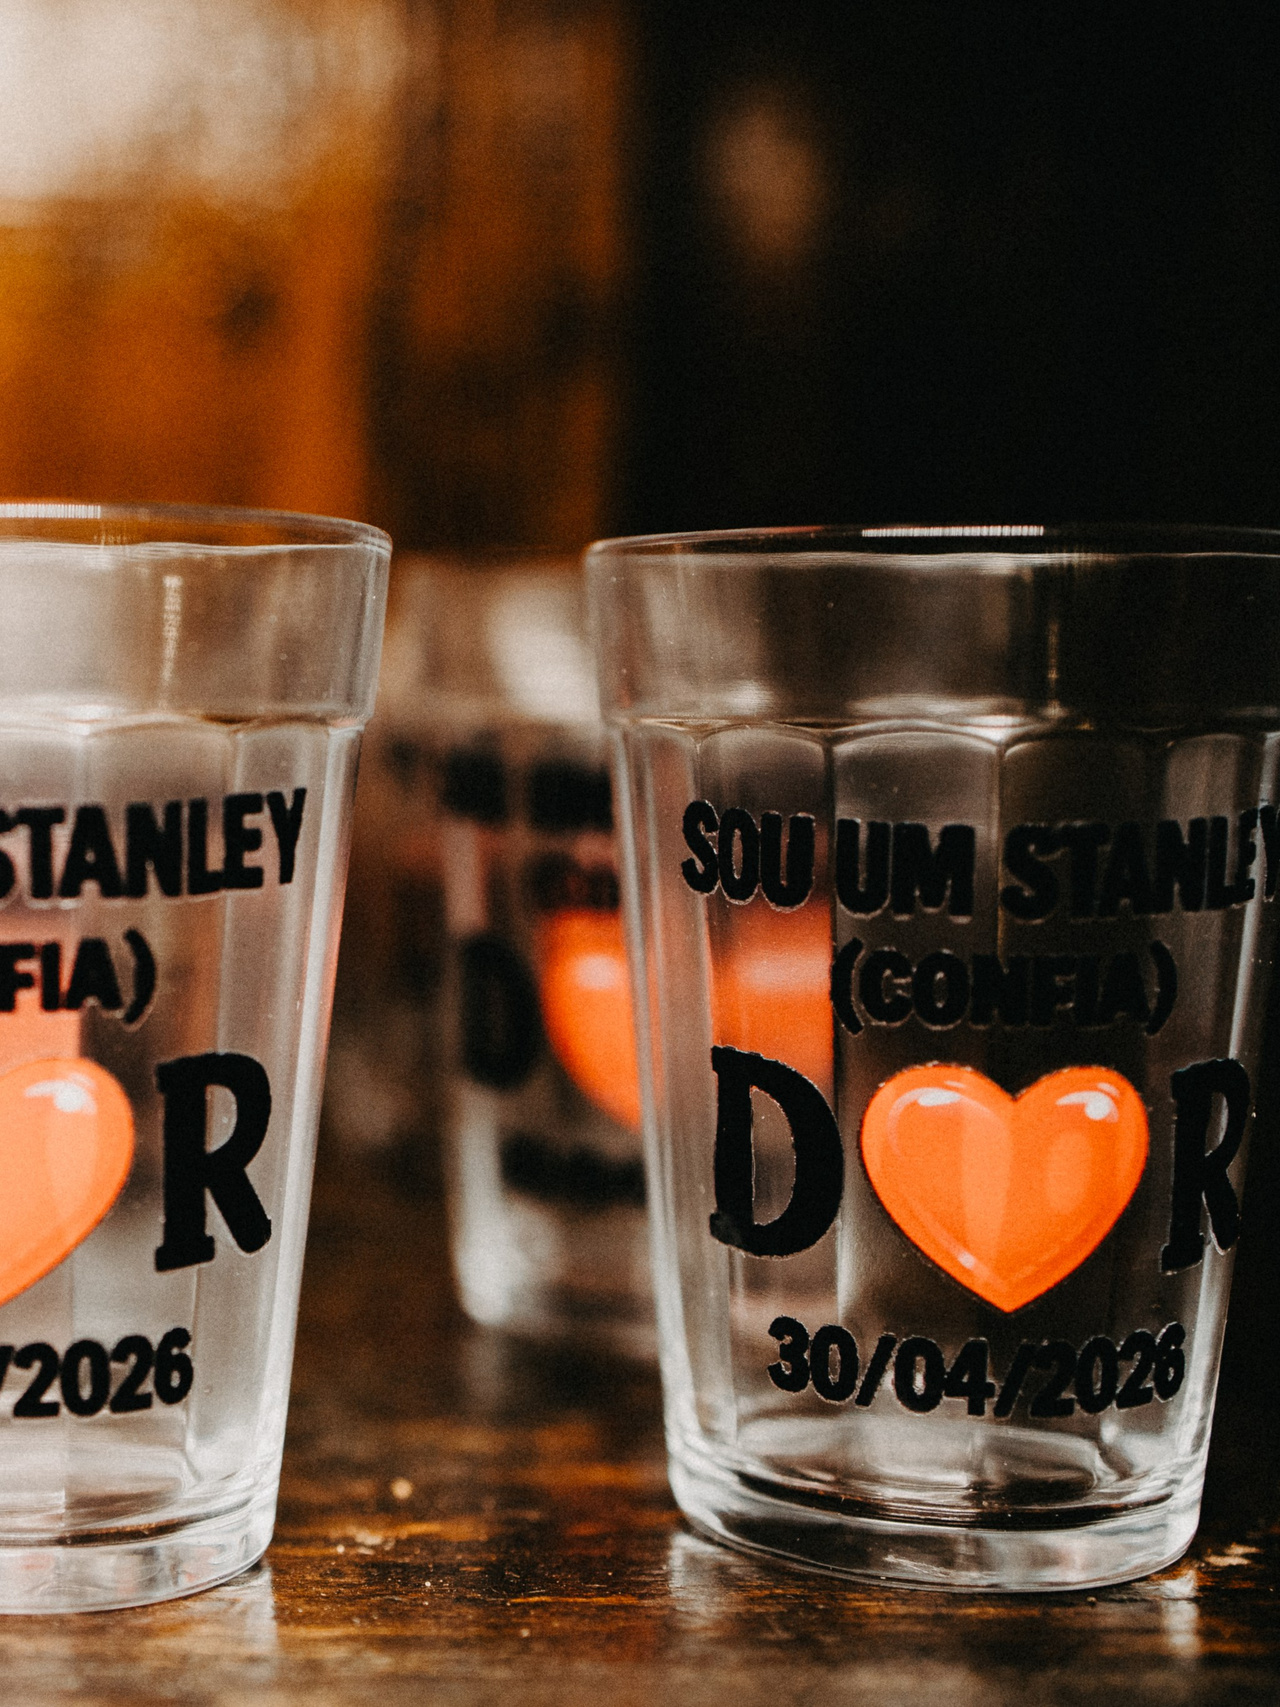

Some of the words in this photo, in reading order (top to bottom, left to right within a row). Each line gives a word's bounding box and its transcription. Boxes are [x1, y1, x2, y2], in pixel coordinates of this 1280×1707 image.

[681, 800, 815, 908] SOU
[836, 818, 975, 916] UM
[832, 939, 1177, 1035] (CONFIA)
[155, 1052, 272, 1271] R
[710, 1045, 844, 1257] D
[1160, 1058, 1250, 1273] R
[768, 1316, 1186, 1417] 30/04/2026
